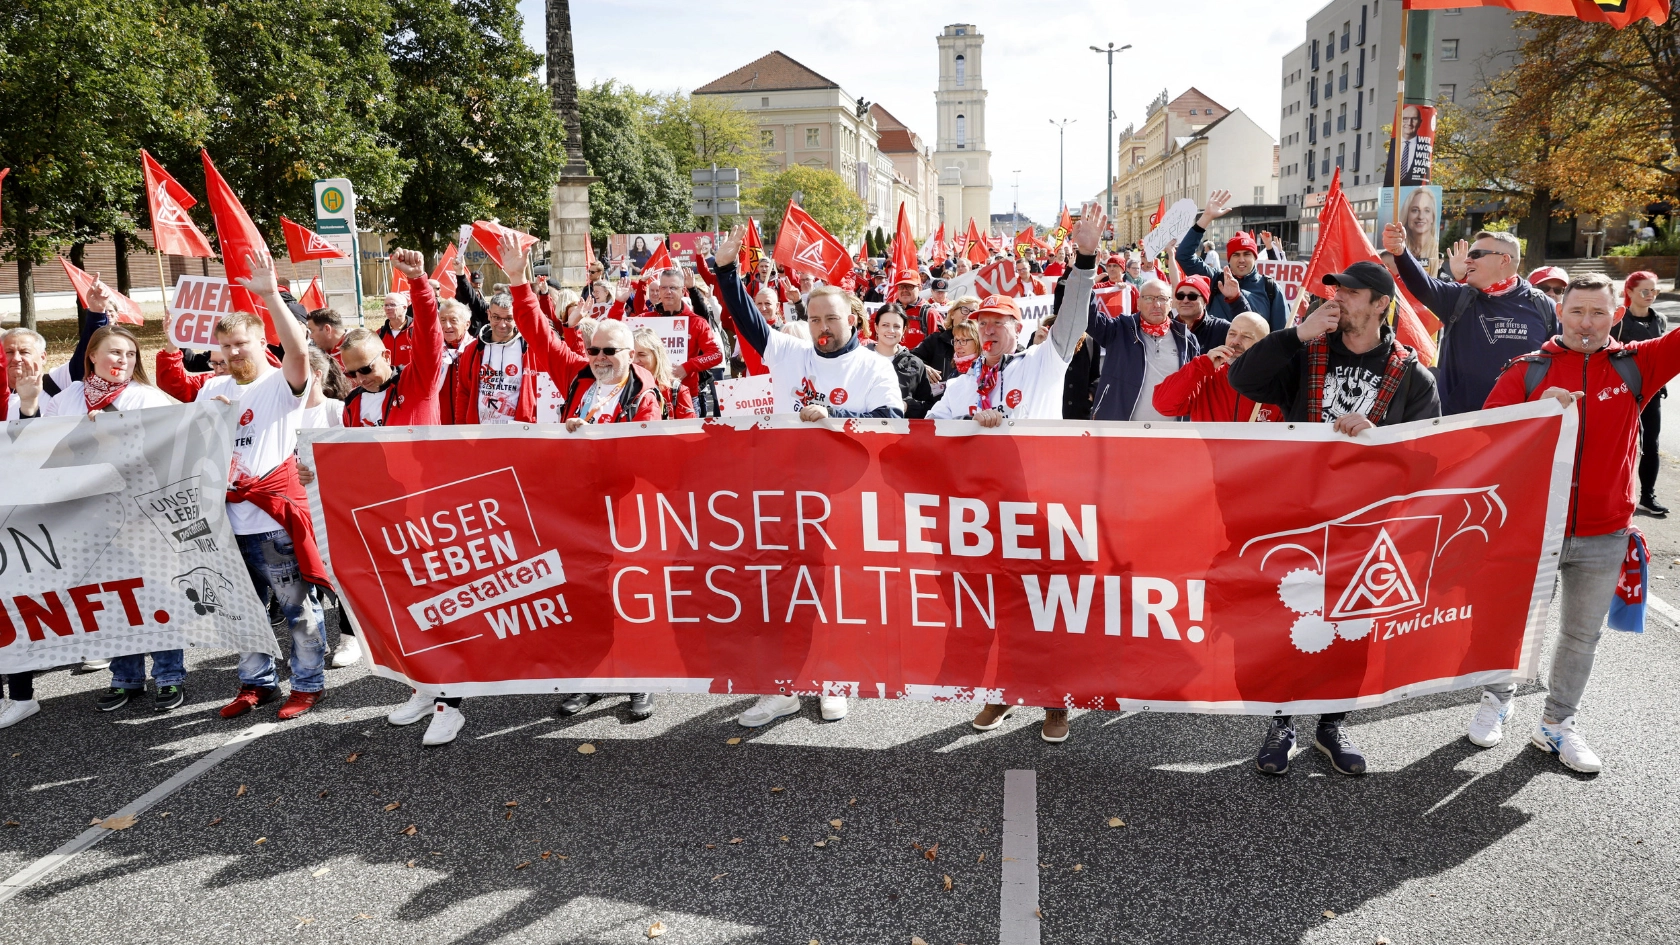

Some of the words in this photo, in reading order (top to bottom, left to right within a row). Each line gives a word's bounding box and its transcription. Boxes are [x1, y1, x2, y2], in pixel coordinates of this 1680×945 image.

[1412, 167, 1427, 175] SPD.
[175, 281, 235, 312] MEH
[660, 336, 685, 348] EHR
[735, 396, 774, 410] SOLIDAR
[753, 406, 774, 416] GEW
[235, 436, 252, 448] TEN
[381, 498, 507, 555] UNSER
[605, 490, 837, 553] UNSER
[861, 491, 1099, 562] LEBEN
[401, 530, 519, 587] LEBEN
[423, 556, 552, 628] gestalten
[612, 565, 996, 630] GESTALTEN
[1021, 574, 1207, 643] WIR!
[484, 593, 573, 640] WIR!
[1382, 604, 1473, 640] Zwickau
